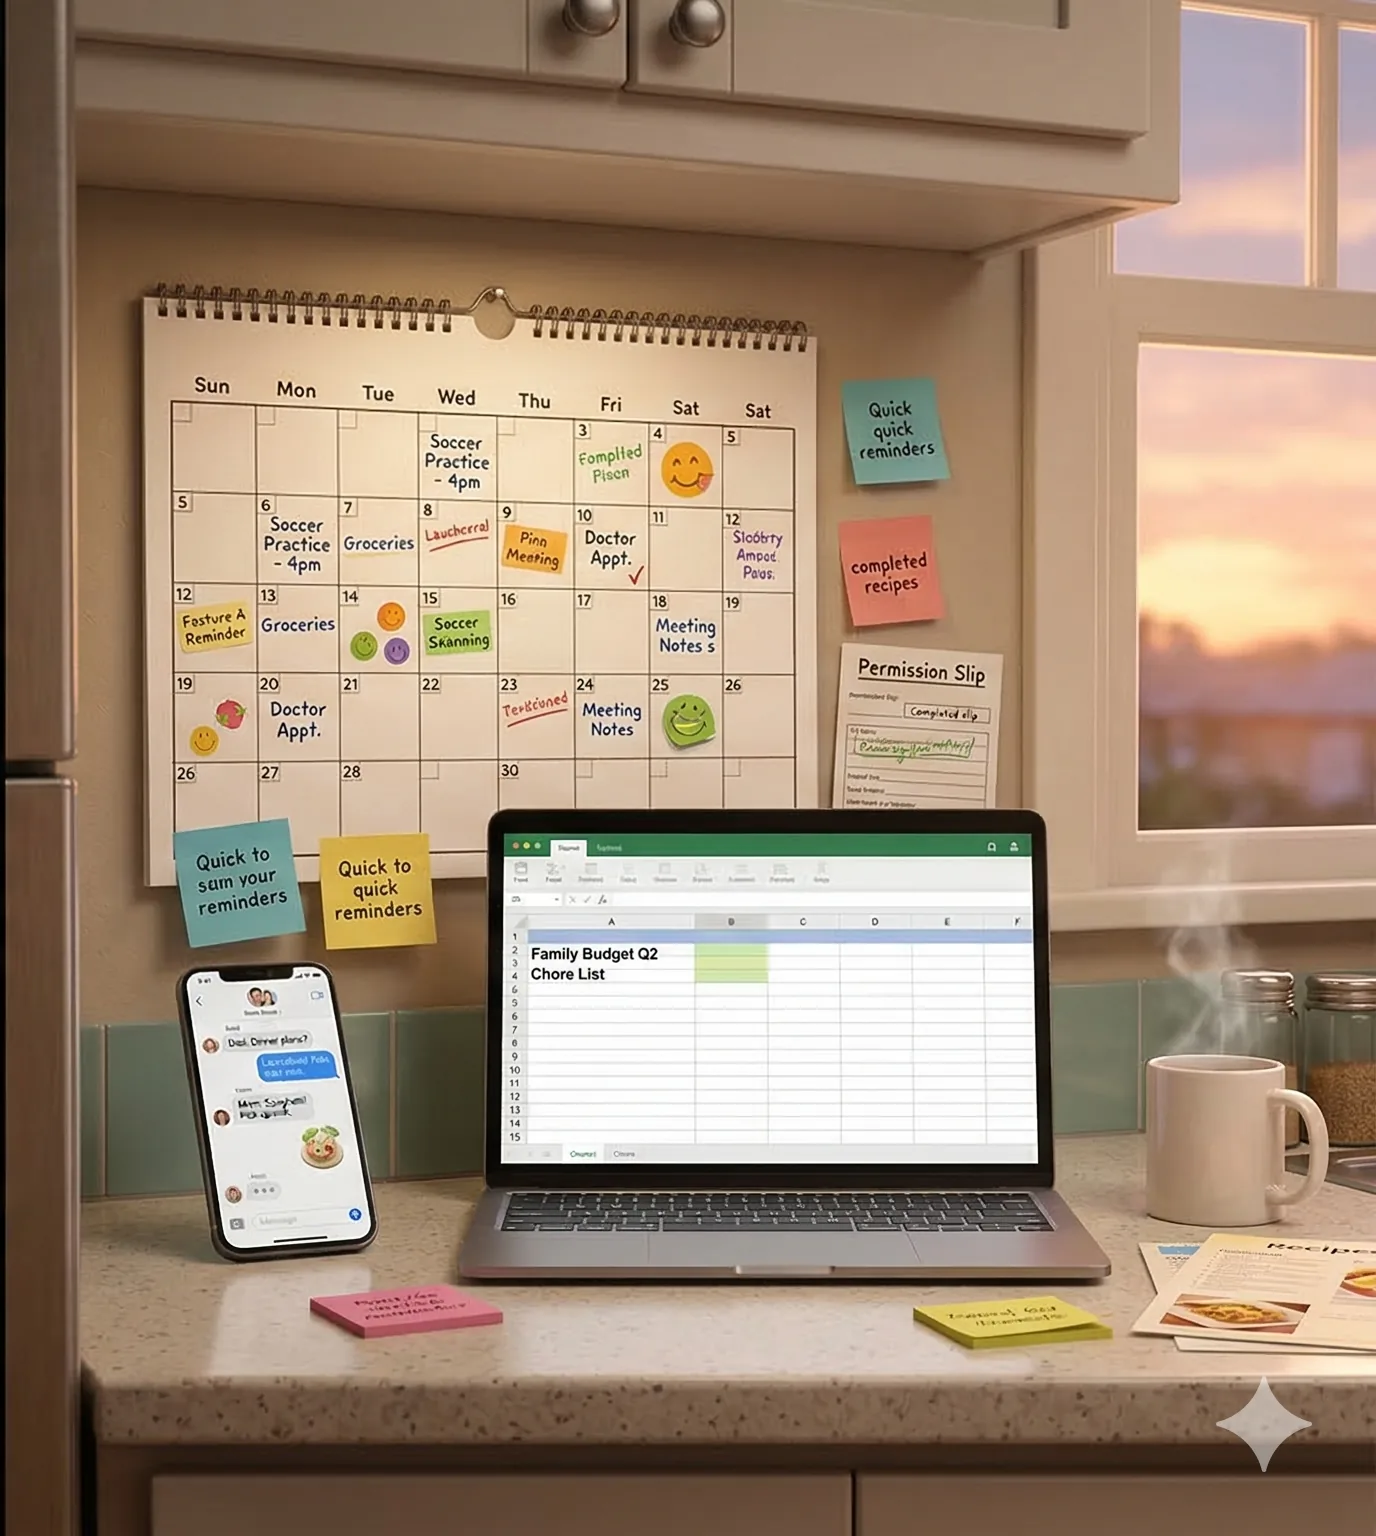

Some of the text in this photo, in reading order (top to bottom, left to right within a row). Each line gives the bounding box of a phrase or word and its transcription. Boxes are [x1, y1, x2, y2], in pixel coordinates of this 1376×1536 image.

[194, 377, 230, 394] Sun
[277, 381, 316, 398] Mon
[363, 385, 394, 401] Tue
[438, 388, 476, 405] Wed
[519, 393, 551, 409] Thu
[601, 397, 622, 412] Fri
[673, 400, 700, 416] Sat
[745, 403, 772, 419] Sat
[868, 401, 912, 419] Quick
[578, 424, 588, 437] 3
[653, 428, 663, 440] 4
[873, 422, 914, 442] quick
[430, 434, 482, 450] Soccer
[727, 431, 736, 443] 5
[860, 441, 935, 460] reminders
[425, 453, 490, 470] Practice
[448, 474, 481, 493] 4pm
[178, 496, 187, 508] 5
[261, 500, 271, 512] 6
[344, 502, 353, 514] 7
[423, 504, 433, 516] 8
[502, 507, 512, 519] 9
[577, 509, 592, 521] 10
[653, 512, 665, 523] 11
[726, 514, 740, 525] 12
[271, 516, 324, 533] Soccer
[264, 535, 331, 553] Practice
[344, 535, 415, 550] Groceries
[585, 530, 636, 546] Doctor
[287, 556, 322, 575] 4pm
[590, 550, 632, 570] Appt.
[851, 552, 927, 576] completed
[865, 577, 919, 596] recipes
[176, 588, 191, 601] 12
[261, 590, 276, 601] 13
[343, 591, 359, 602] 14
[423, 592, 437, 604] 15
[501, 593, 516, 605] 16
[577, 595, 592, 606] 17
[652, 596, 667, 608] 18
[725, 597, 739, 609] 19
[236, 608, 246, 620] A
[261, 617, 336, 633] Groceries
[435, 617, 479, 630] Soccer
[655, 618, 716, 638] Meeting
[185, 626, 246, 646] Reminder
[660, 638, 716, 653] Notes s
[858, 658, 986, 687] Permission Slip
[177, 678, 192, 690] 19
[260, 678, 279, 690] 20
[343, 678, 358, 690] 21
[422, 679, 440, 690] 22
[501, 679, 518, 691] 23
[576, 679, 594, 691] 24
[652, 679, 669, 691] 25
[725, 679, 742, 691] 26
[271, 701, 327, 717] Doctor
[582, 703, 642, 721] Meeting
[277, 723, 321, 742] Appt.
[591, 723, 634, 736] Notes
[177, 768, 195, 780] 26
[261, 767, 279, 779] 27
[343, 766, 361, 778] 28
[501, 764, 519, 777] 30
[196, 847, 270, 872] Quick to
[339, 858, 412, 878] Quick to
[239, 870, 276, 888] your
[353, 880, 398, 902] quick
[198, 890, 288, 915] reminders
[335, 902, 423, 921] reminders
[608, 917, 616, 926] A
[800, 917, 807, 926] C
[871, 917, 879, 926] D
[944, 917, 951, 926] E
[512, 946, 518, 954] 2
[531, 947, 658, 963] Family Budget Q2
[512, 959, 518, 967] 3
[512, 972, 518, 980] 4
[531, 967, 605, 980] Chore List
[512, 999, 518, 1007] 5
[512, 1012, 518, 1020] 6
[512, 1053, 518, 1061] 9
[510, 1066, 520, 1074] 10
[510, 1079, 519, 1087] 11
[510, 1092, 520, 1101] 12
[510, 1106, 520, 1114] 13
[510, 1119, 520, 1128] 14
[510, 1133, 520, 1141] 15
